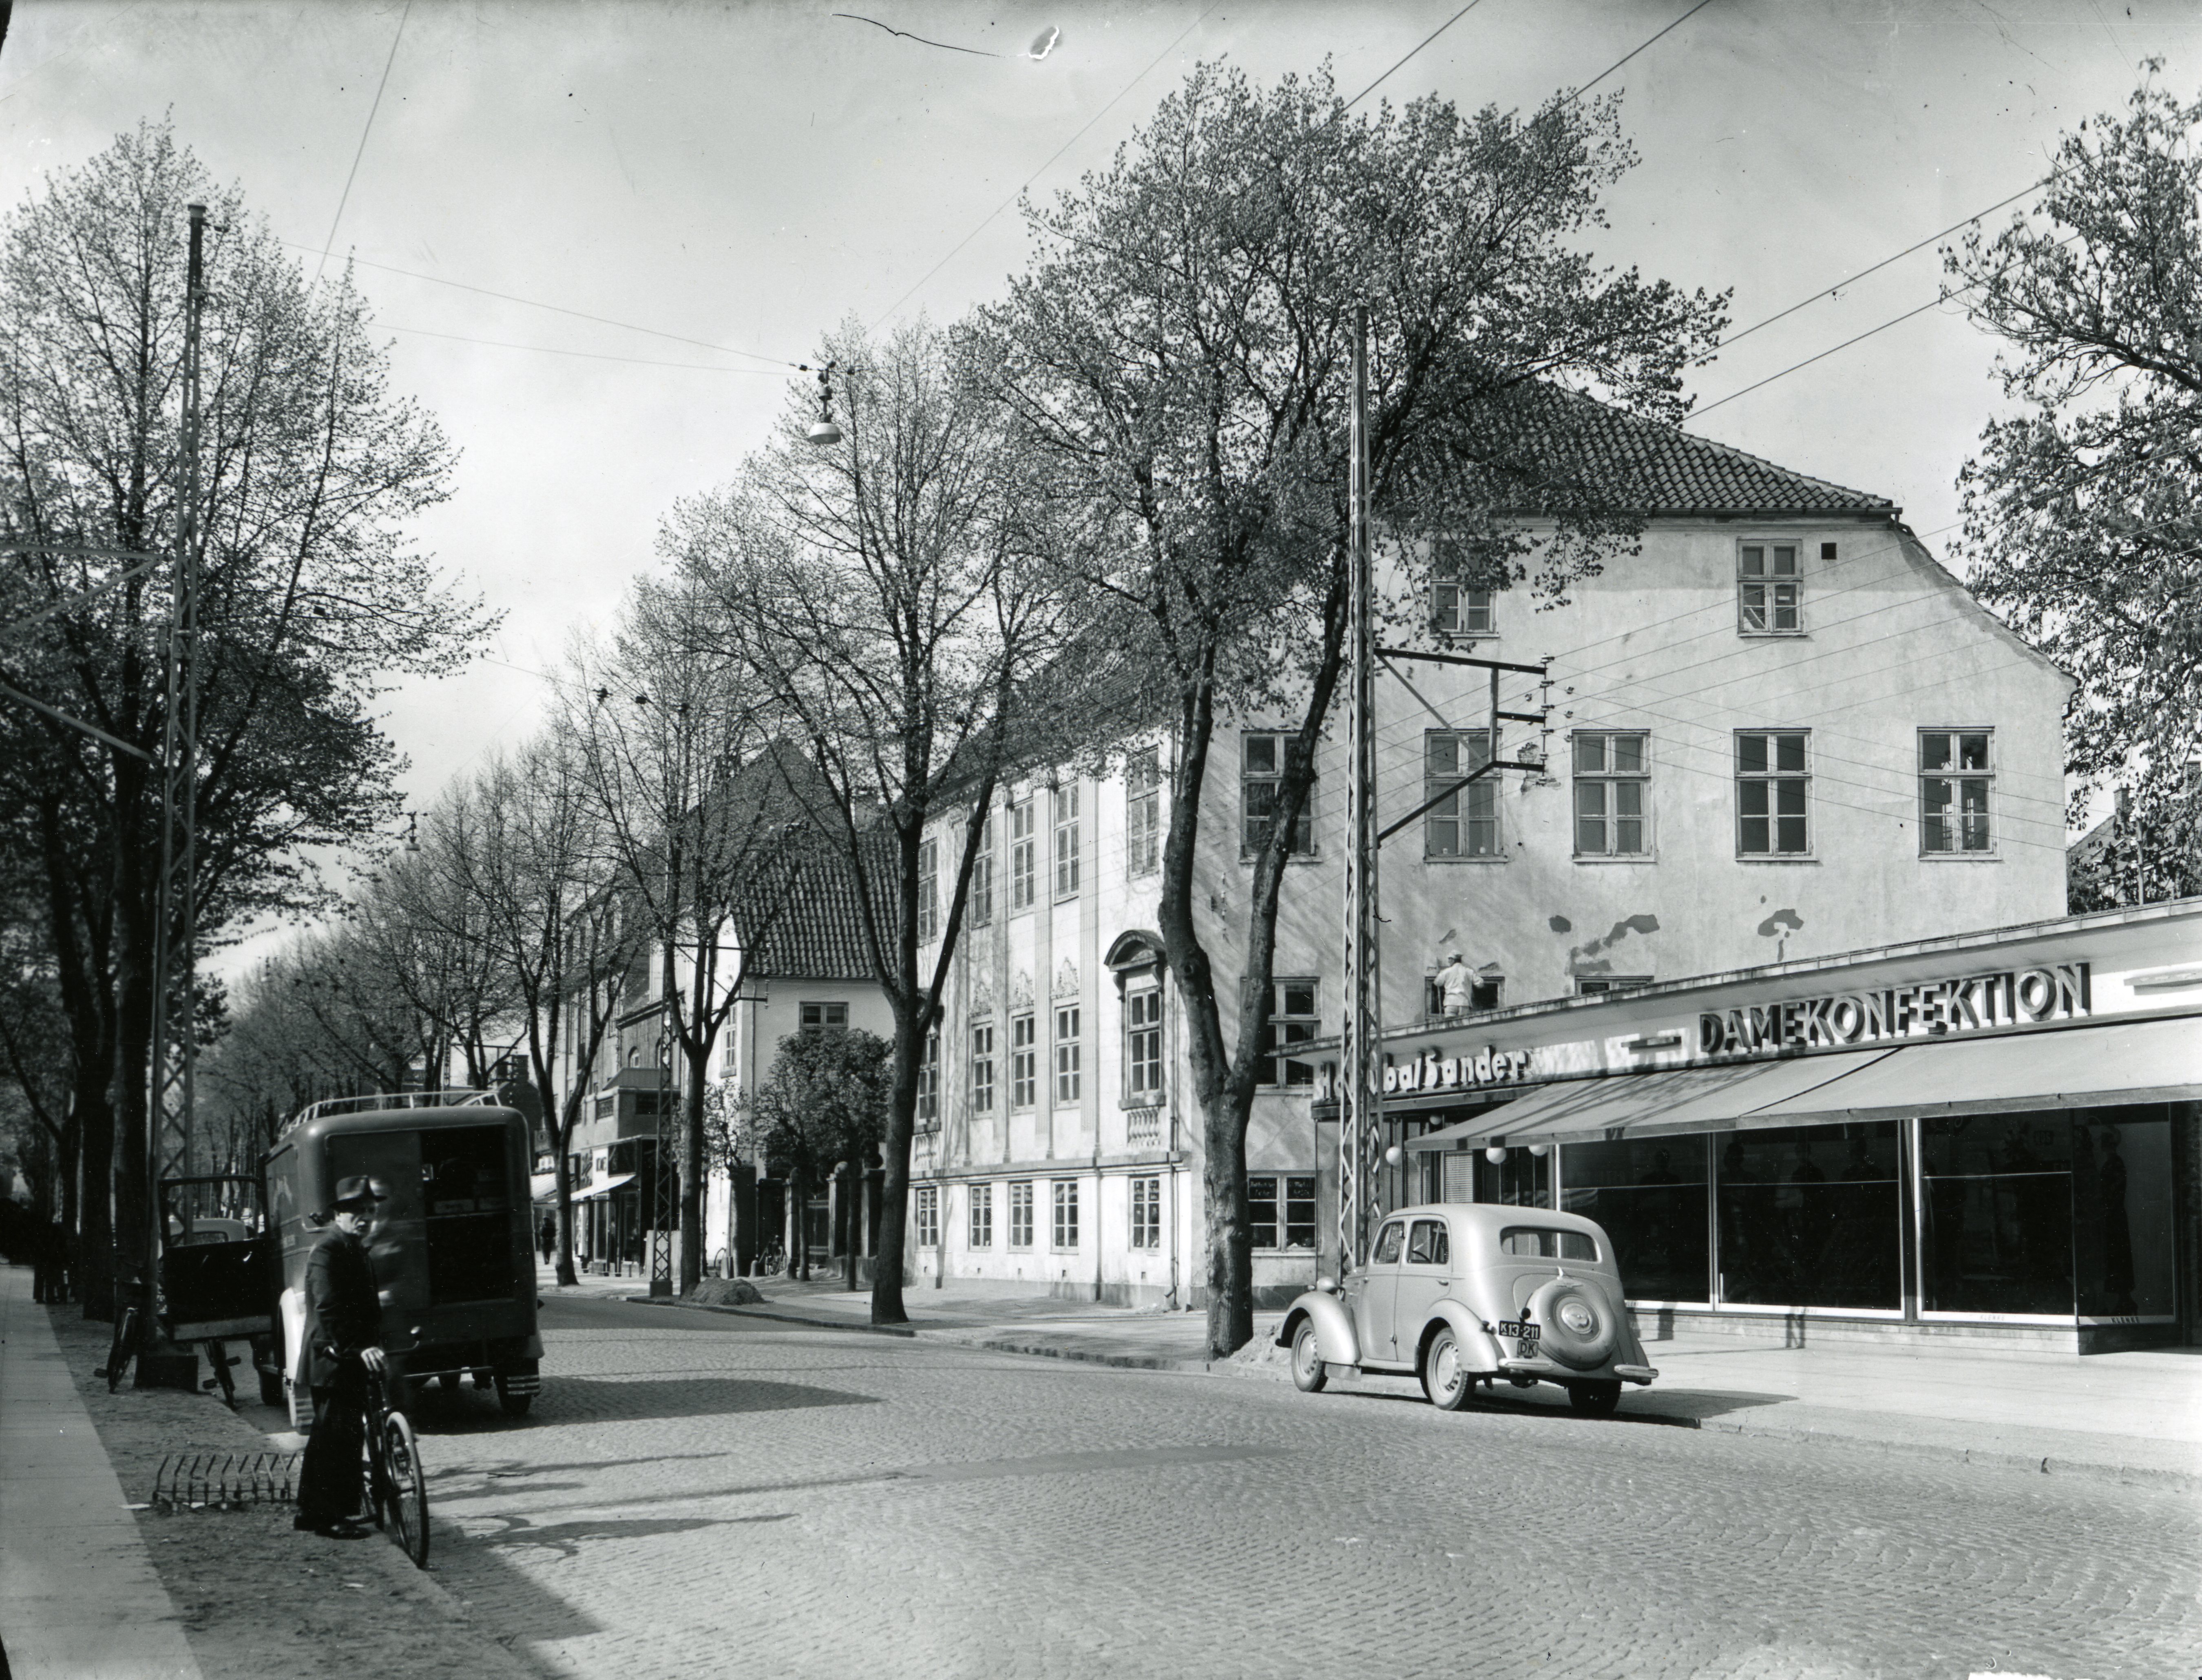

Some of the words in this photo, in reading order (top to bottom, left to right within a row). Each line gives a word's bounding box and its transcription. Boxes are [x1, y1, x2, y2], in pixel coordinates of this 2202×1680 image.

[1699, 962, 2091, 1053] DAMEKONFEKTION
[1424, 1045, 1528, 1089] Sander
[1520, 1342, 1535, 1356] DK
